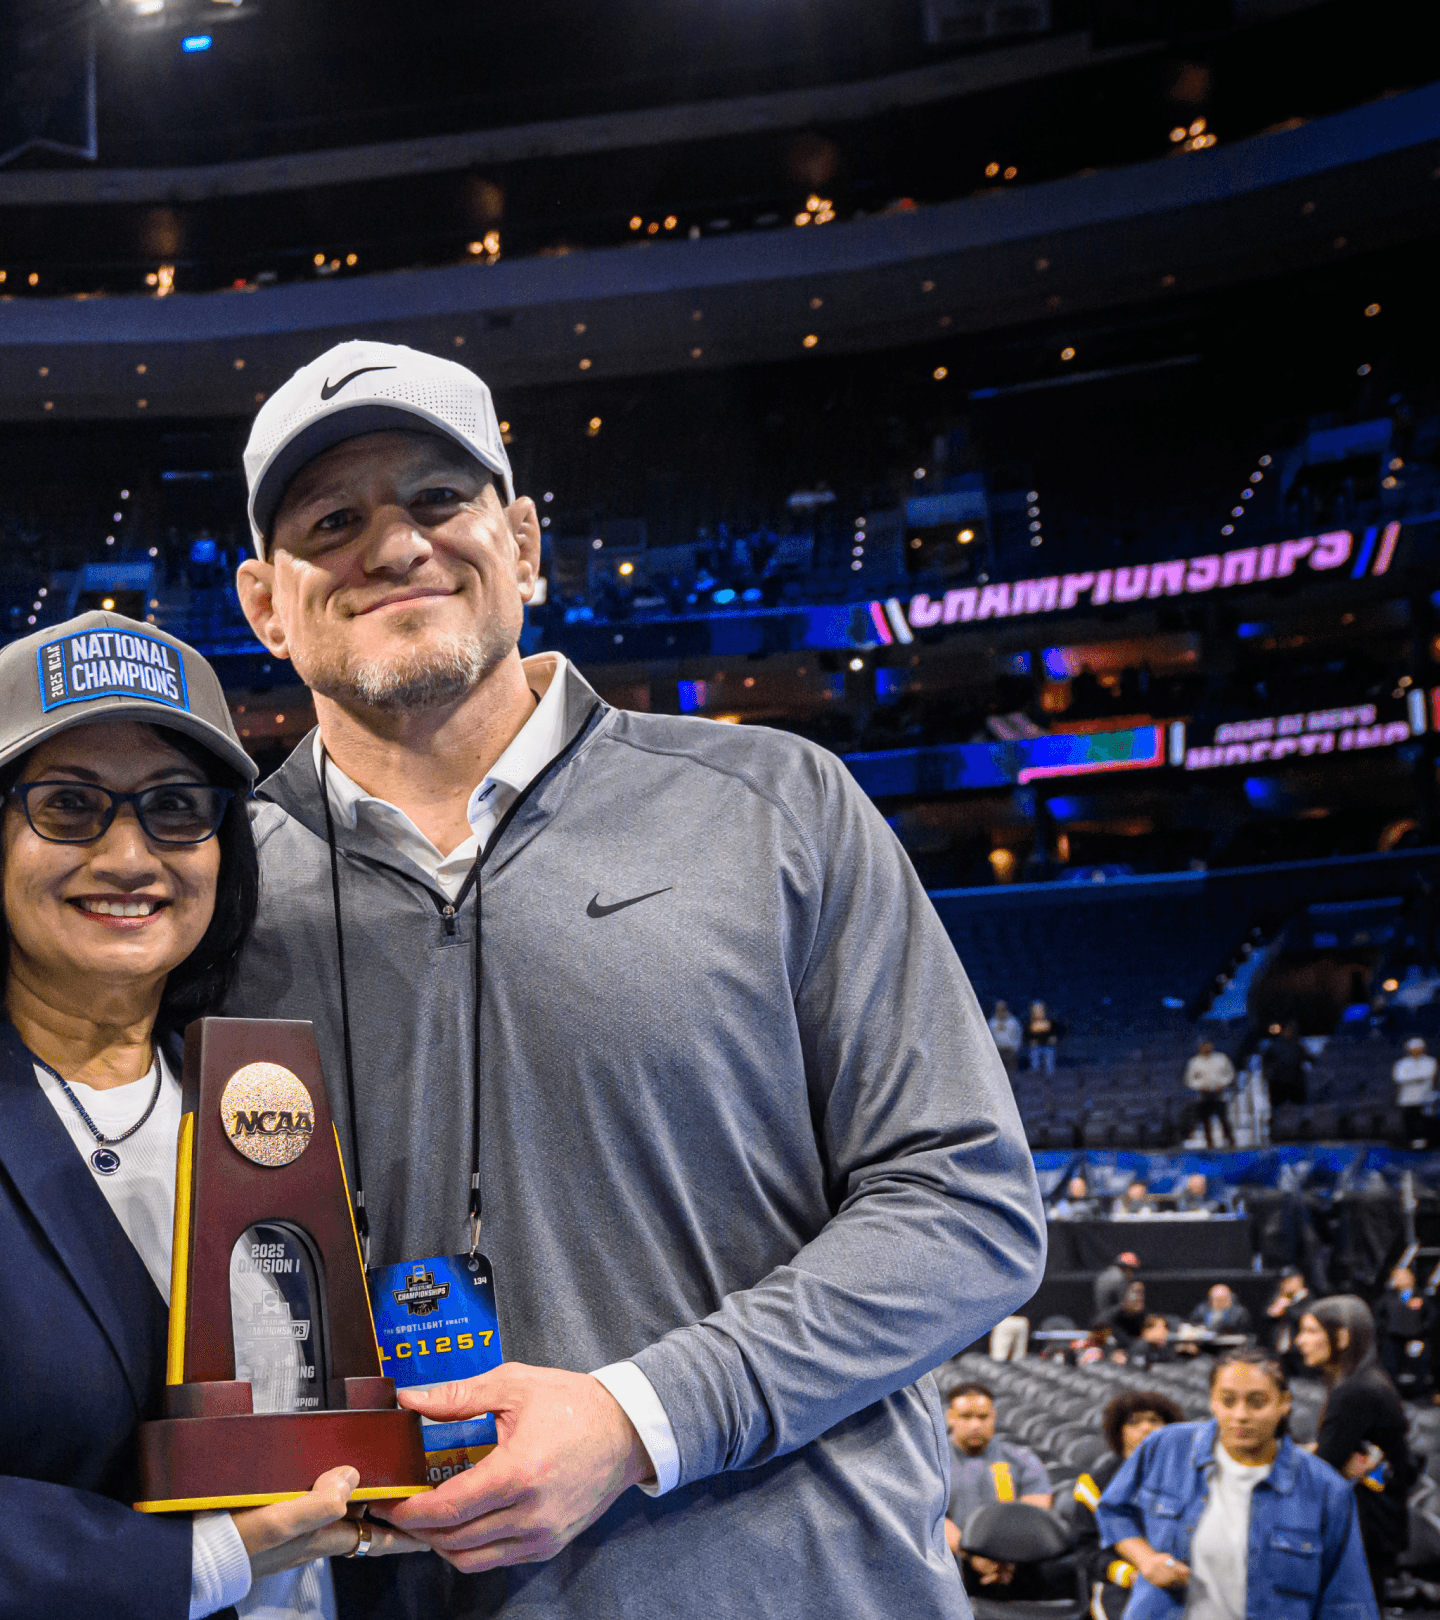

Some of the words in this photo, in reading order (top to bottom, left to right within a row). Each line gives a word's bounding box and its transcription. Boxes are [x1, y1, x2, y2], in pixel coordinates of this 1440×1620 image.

[71, 632, 176, 673] NATIONAL
[51, 671, 65, 698] 2025
[71, 659, 179, 700] CHAMPIONS
[235, 1110, 314, 1136] NCAA
[250, 1243, 285, 1259] 2025
[238, 1258, 293, 1274] DIVISION
[295, 1258, 301, 1274] I
[397, 1287, 446, 1301] CHAMPIONSHIPS
[395, 1319, 444, 1335] SPOTLIGHT
[378, 1329, 494, 1362] LC1257
